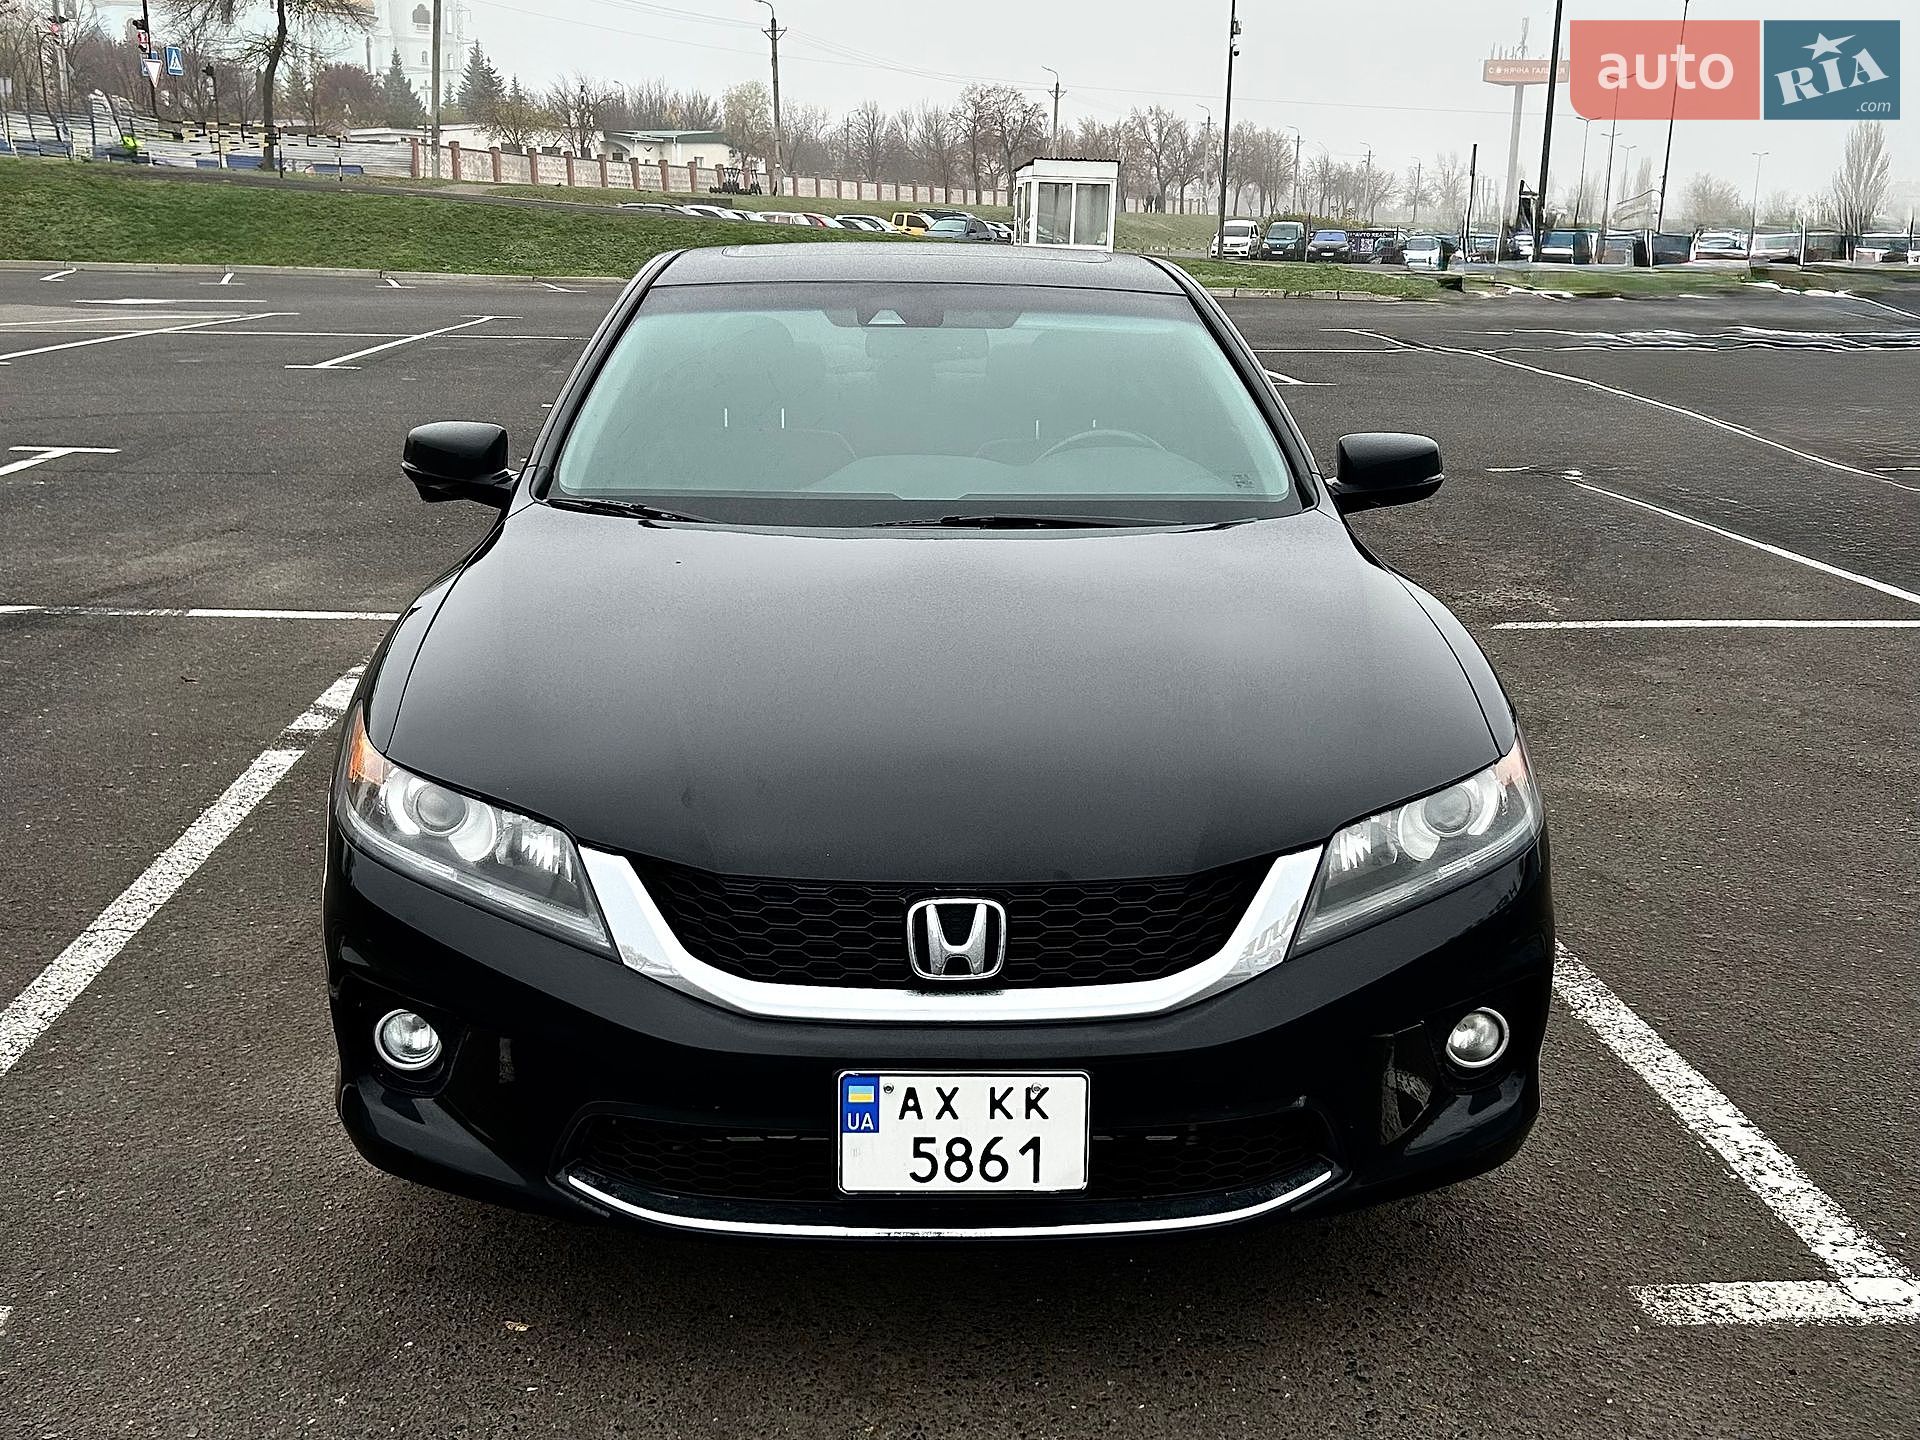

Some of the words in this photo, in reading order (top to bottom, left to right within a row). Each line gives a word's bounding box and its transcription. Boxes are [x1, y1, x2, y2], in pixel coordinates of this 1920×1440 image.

[898, 1086, 960, 1120] AX
[989, 1086, 1050, 1120] KK
[847, 1112, 874, 1131] UA
[909, 1136, 1041, 1183] 5861
